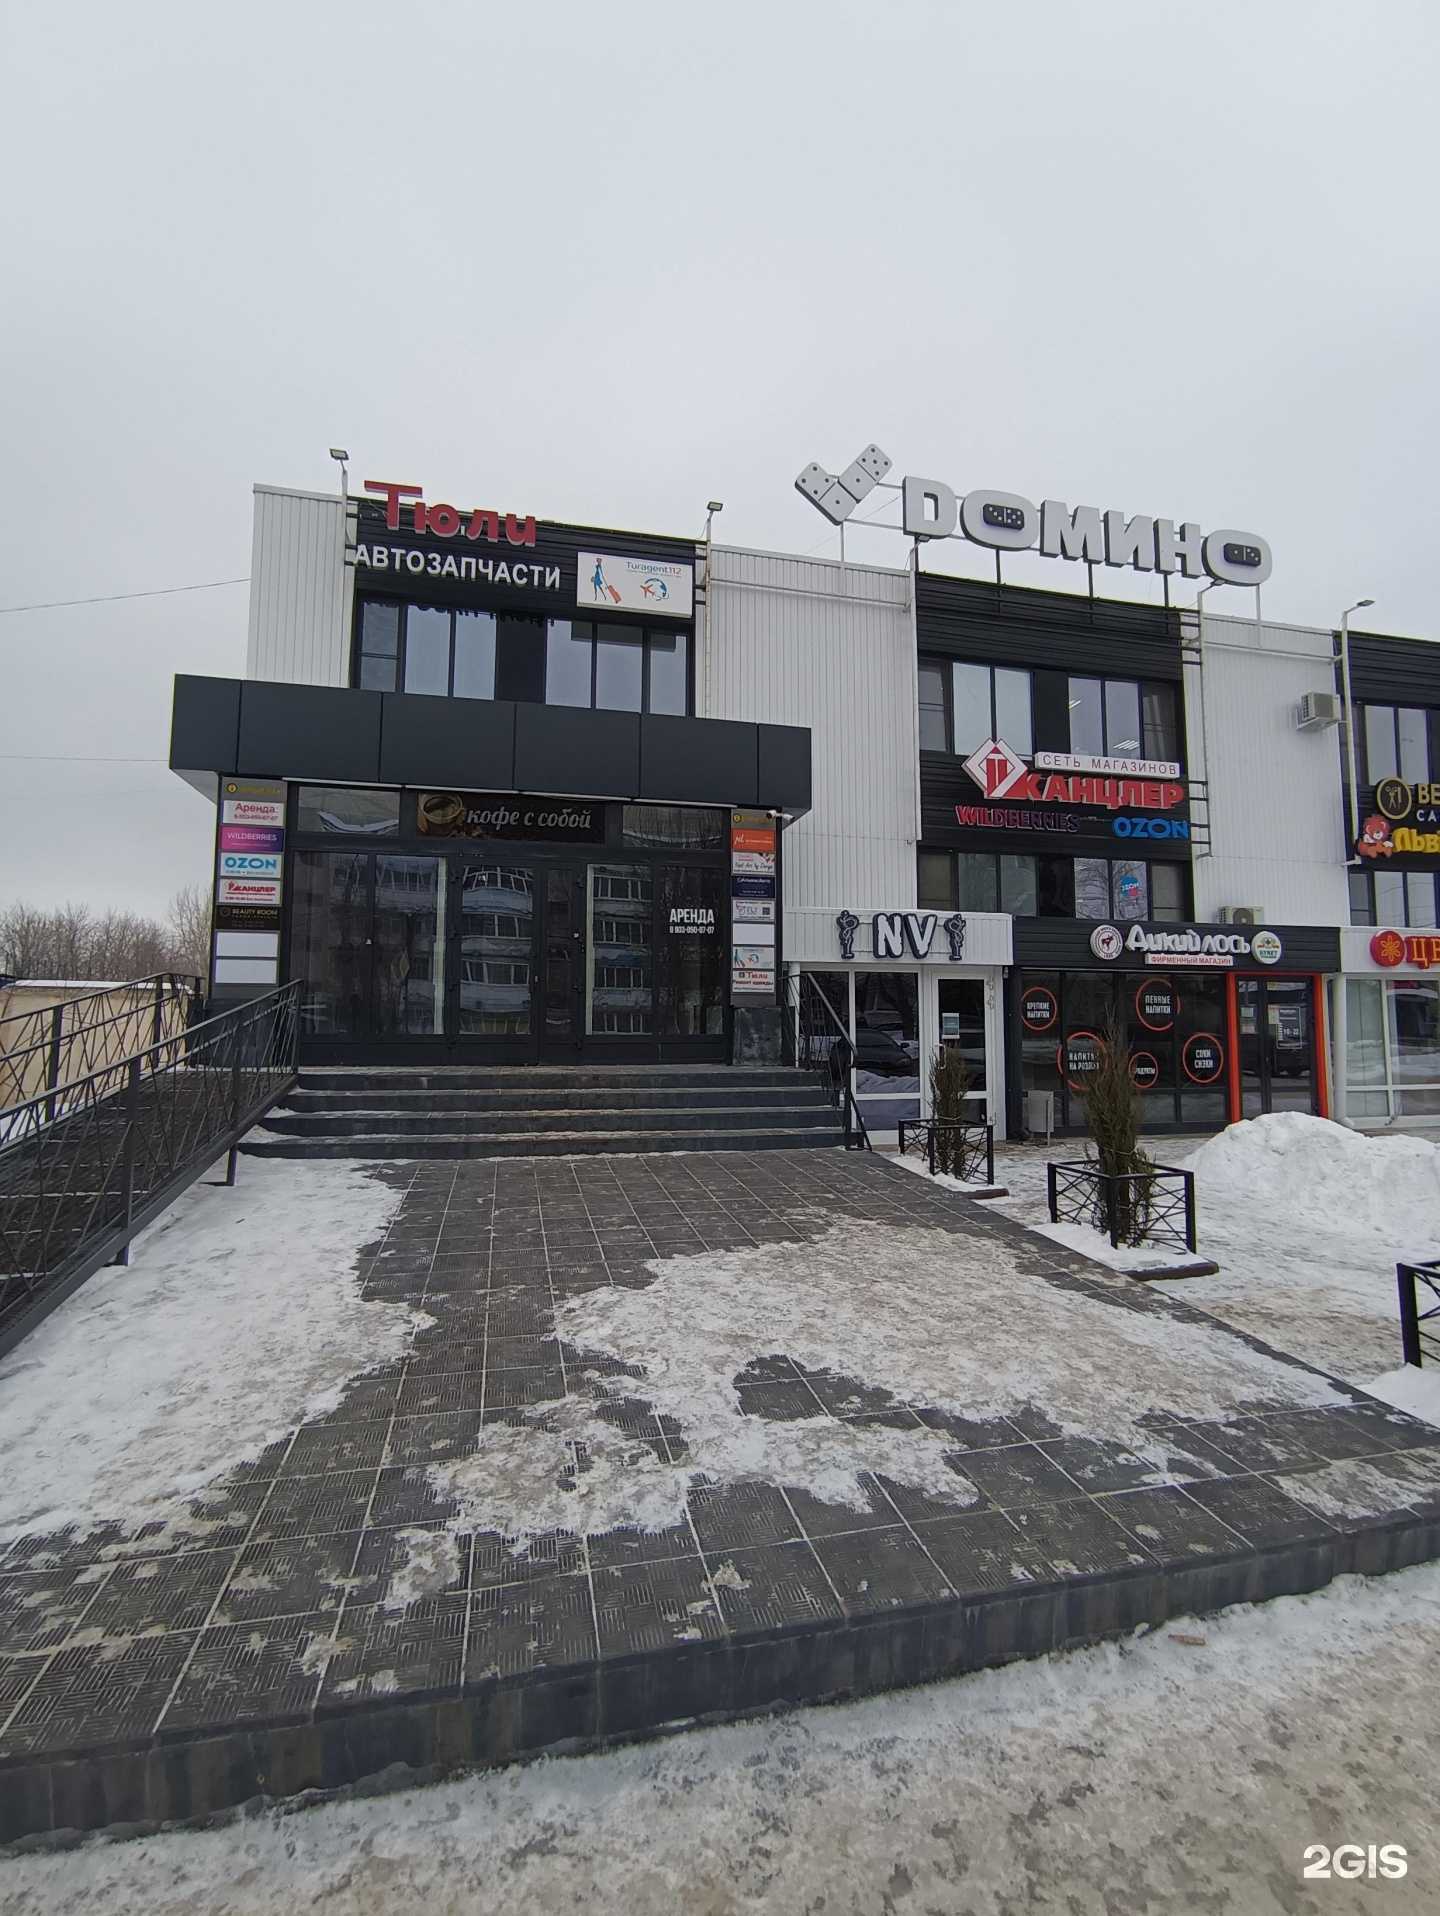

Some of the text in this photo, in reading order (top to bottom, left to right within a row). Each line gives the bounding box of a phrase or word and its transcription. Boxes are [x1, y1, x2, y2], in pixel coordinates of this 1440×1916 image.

[364, 480, 537, 547] Тюли
[353, 544, 561, 591] АВТОЗАПЧАСТИ
[1042, 754, 1177, 776] СЕТЬ МАГАЗИНОВ
[1010, 773, 1186, 810] КАНЦЛЕР
[235, 803, 276, 813] Аренда
[466, 806, 592, 830] кофе с собой
[955, 805, 1082, 833] WILDBERRIES
[1112, 816, 1190, 839] OZON
[226, 832, 277, 841] WILDBERRIES
[224, 857, 277, 869] OZON
[669, 908, 715, 925] АРЕНДА
[872, 913, 938, 959] NV
[1151, 955, 1231, 966] ФИРМЕННЫЙ МАГАЗИН
[1145, 995, 1171, 1004] ПЕННЫЕ
[1145, 1005, 1171, 1014] НАПИТКИ
[1195, 1049, 1212, 1059] СОКИ
[1069, 1062, 1077, 1071] НА
